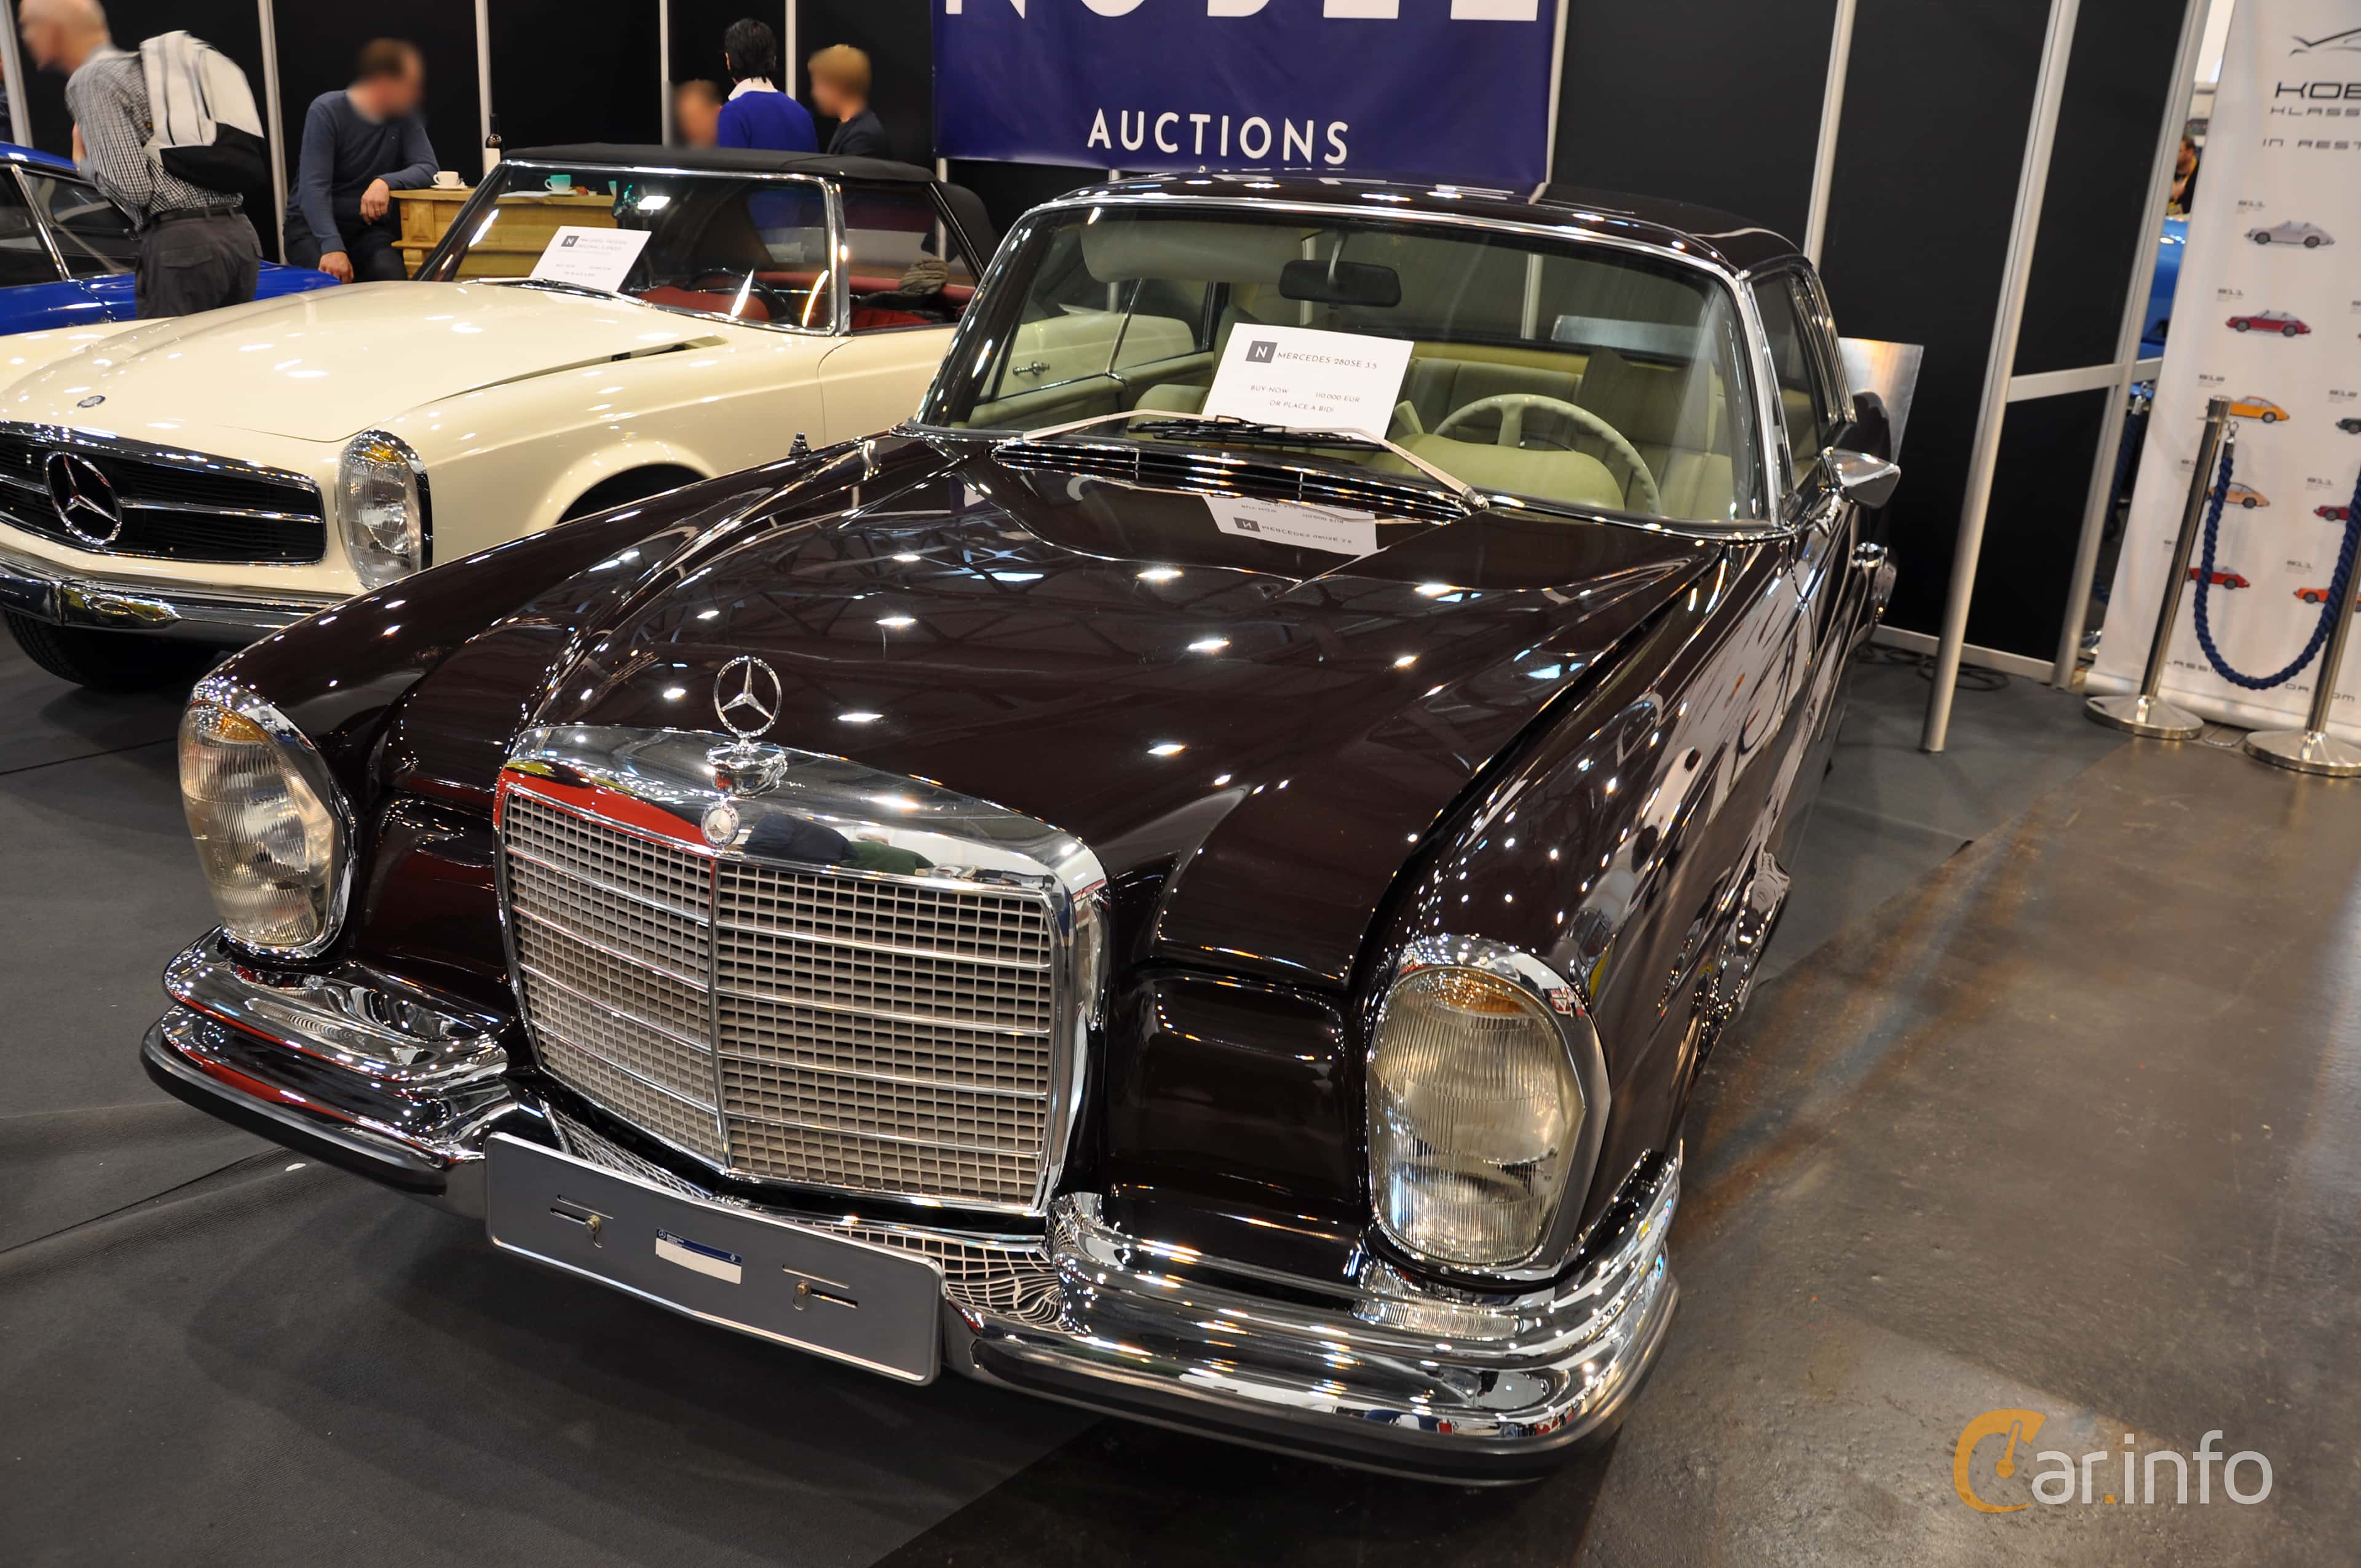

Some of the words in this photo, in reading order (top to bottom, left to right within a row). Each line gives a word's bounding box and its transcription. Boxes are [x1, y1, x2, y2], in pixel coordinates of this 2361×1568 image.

[1088, 108, 1348, 165] AUCTIONS
[1255, 345, 1268, 358] N
[1277, 352, 1331, 363] MERCEDES
[1334, 358, 1361, 368] 280SE
[1344, 394, 1360, 403] EUR
[1283, 401, 1308, 411] PLACE
